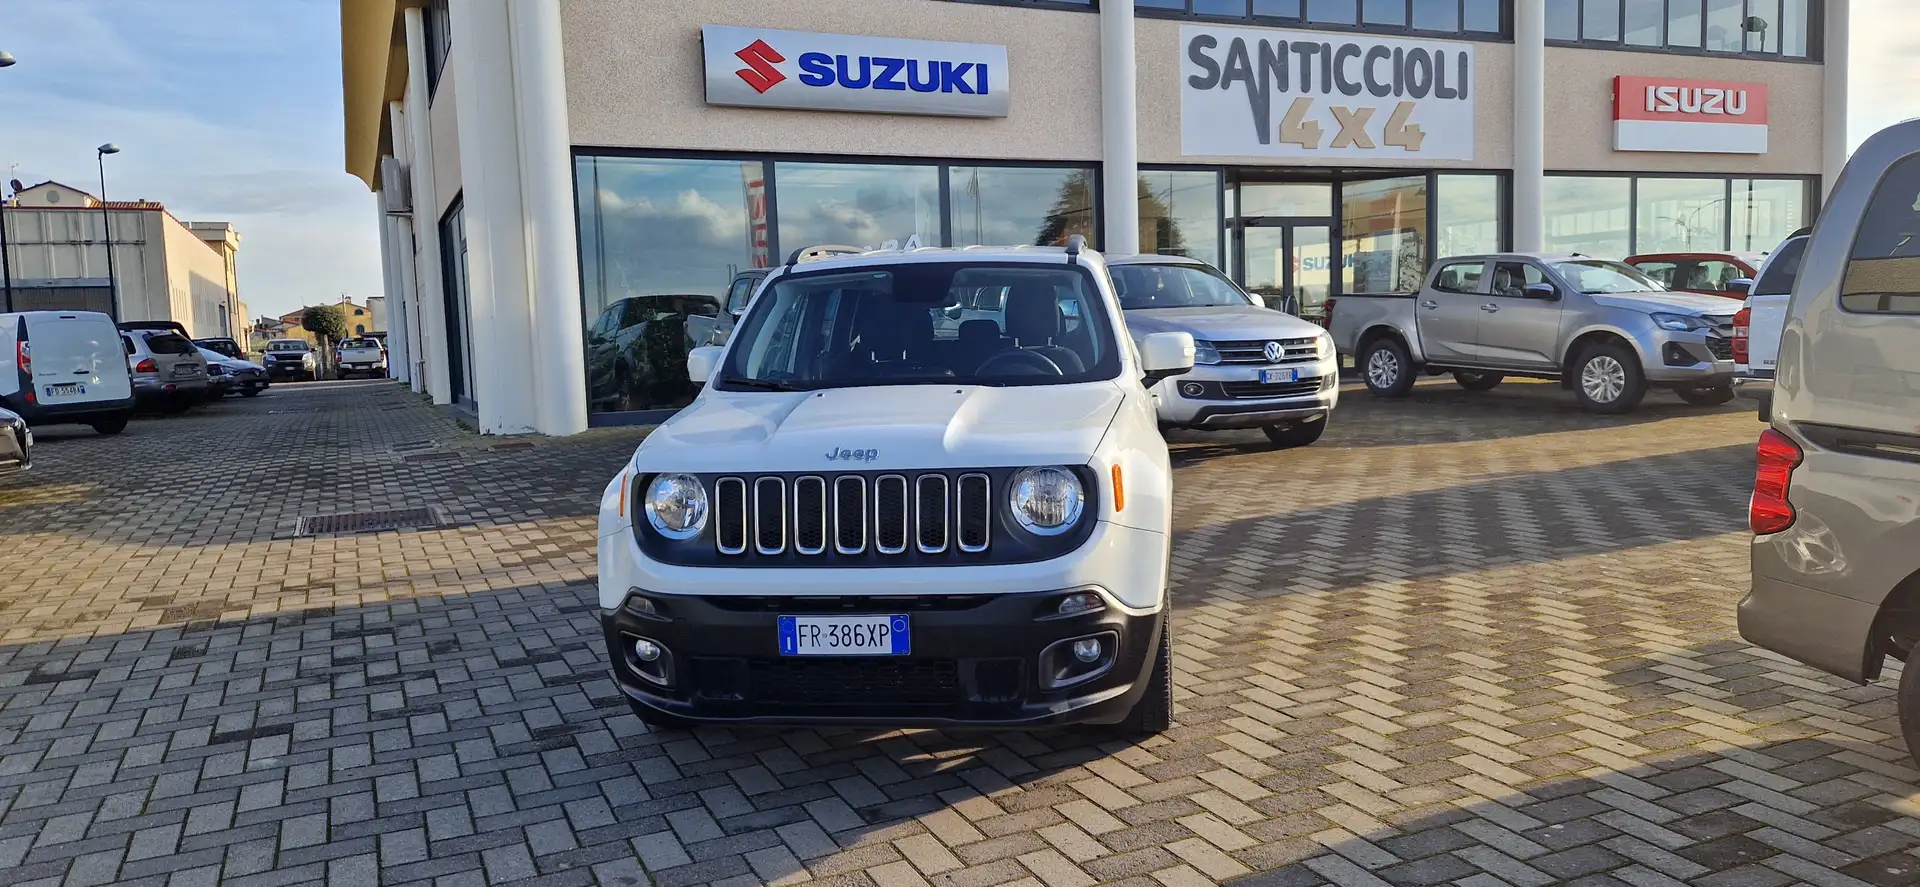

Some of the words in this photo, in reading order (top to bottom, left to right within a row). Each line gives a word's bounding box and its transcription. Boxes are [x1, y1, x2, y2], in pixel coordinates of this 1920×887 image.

[798, 52, 988, 94] SUZUKI
[1188, 34, 1468, 144] SANTICCIOLI
[1645, 85, 1746, 115] ISUZU
[825, 446, 880, 464] Jeep
